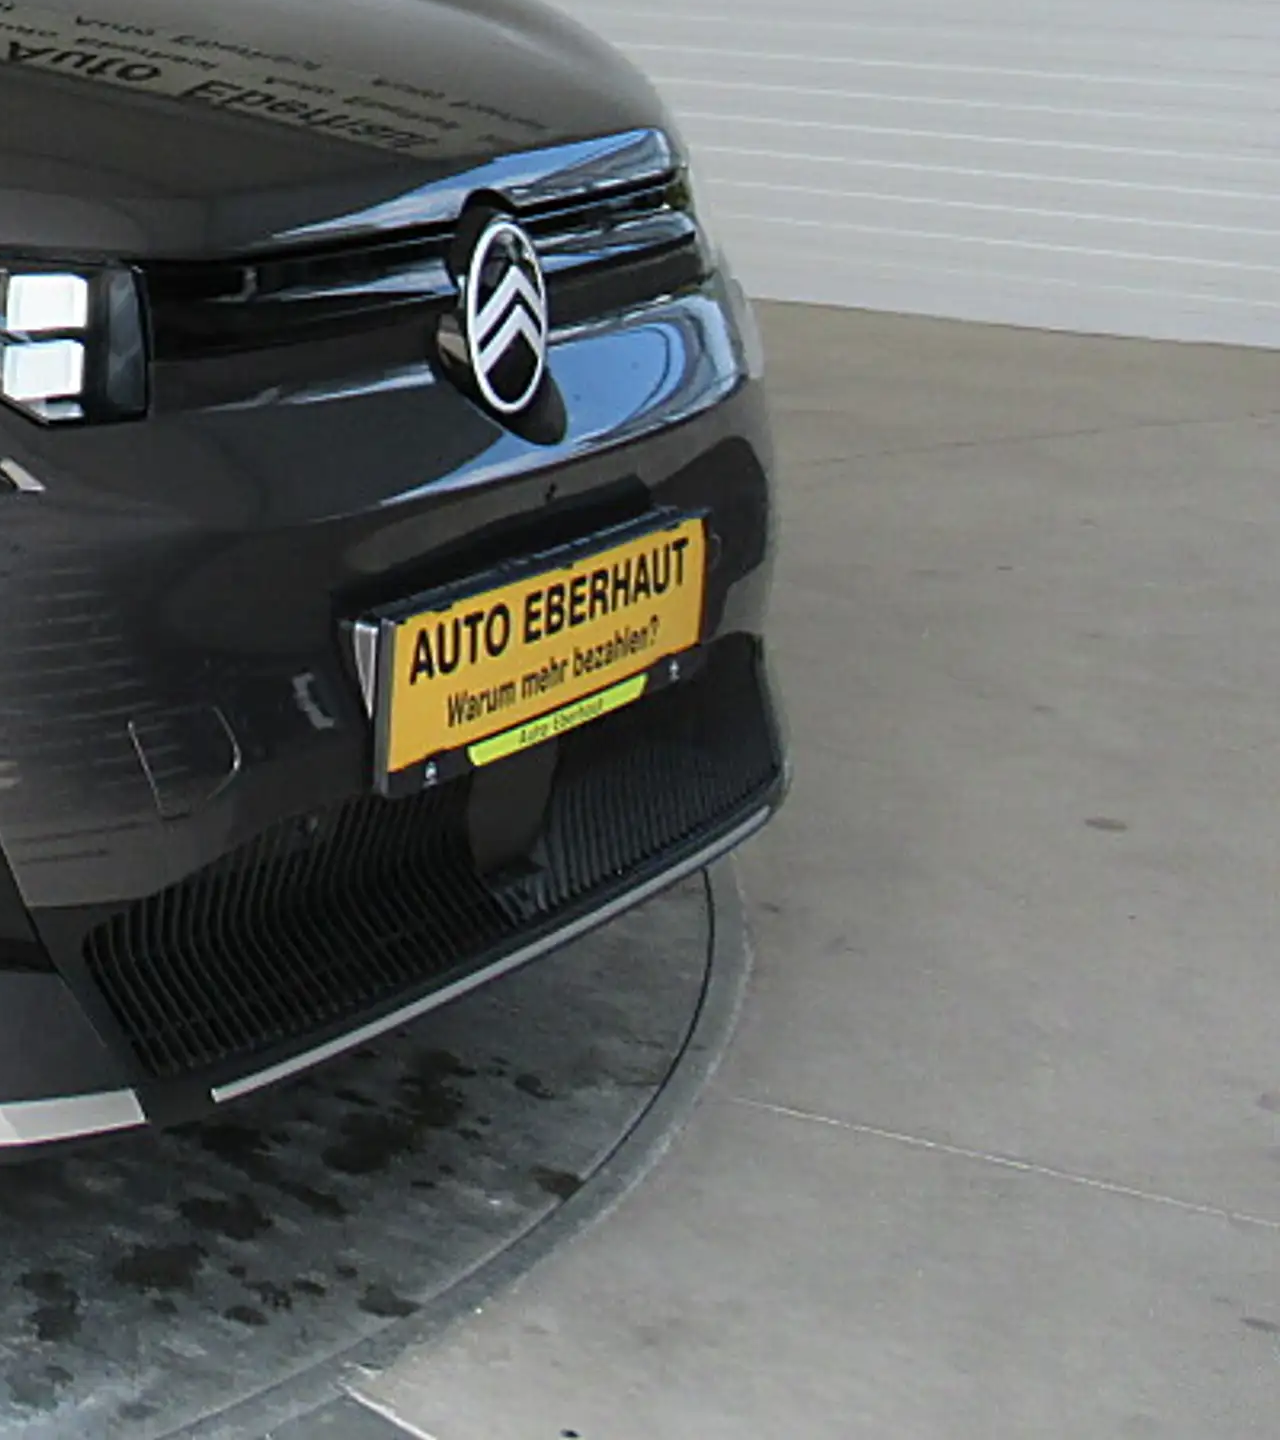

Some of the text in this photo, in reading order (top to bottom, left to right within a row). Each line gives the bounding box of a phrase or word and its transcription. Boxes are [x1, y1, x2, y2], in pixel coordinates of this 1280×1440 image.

[409, 537, 690, 685] AUTO EBERHAUT
[446, 615, 661, 728] Warum mehr bezahlen?
